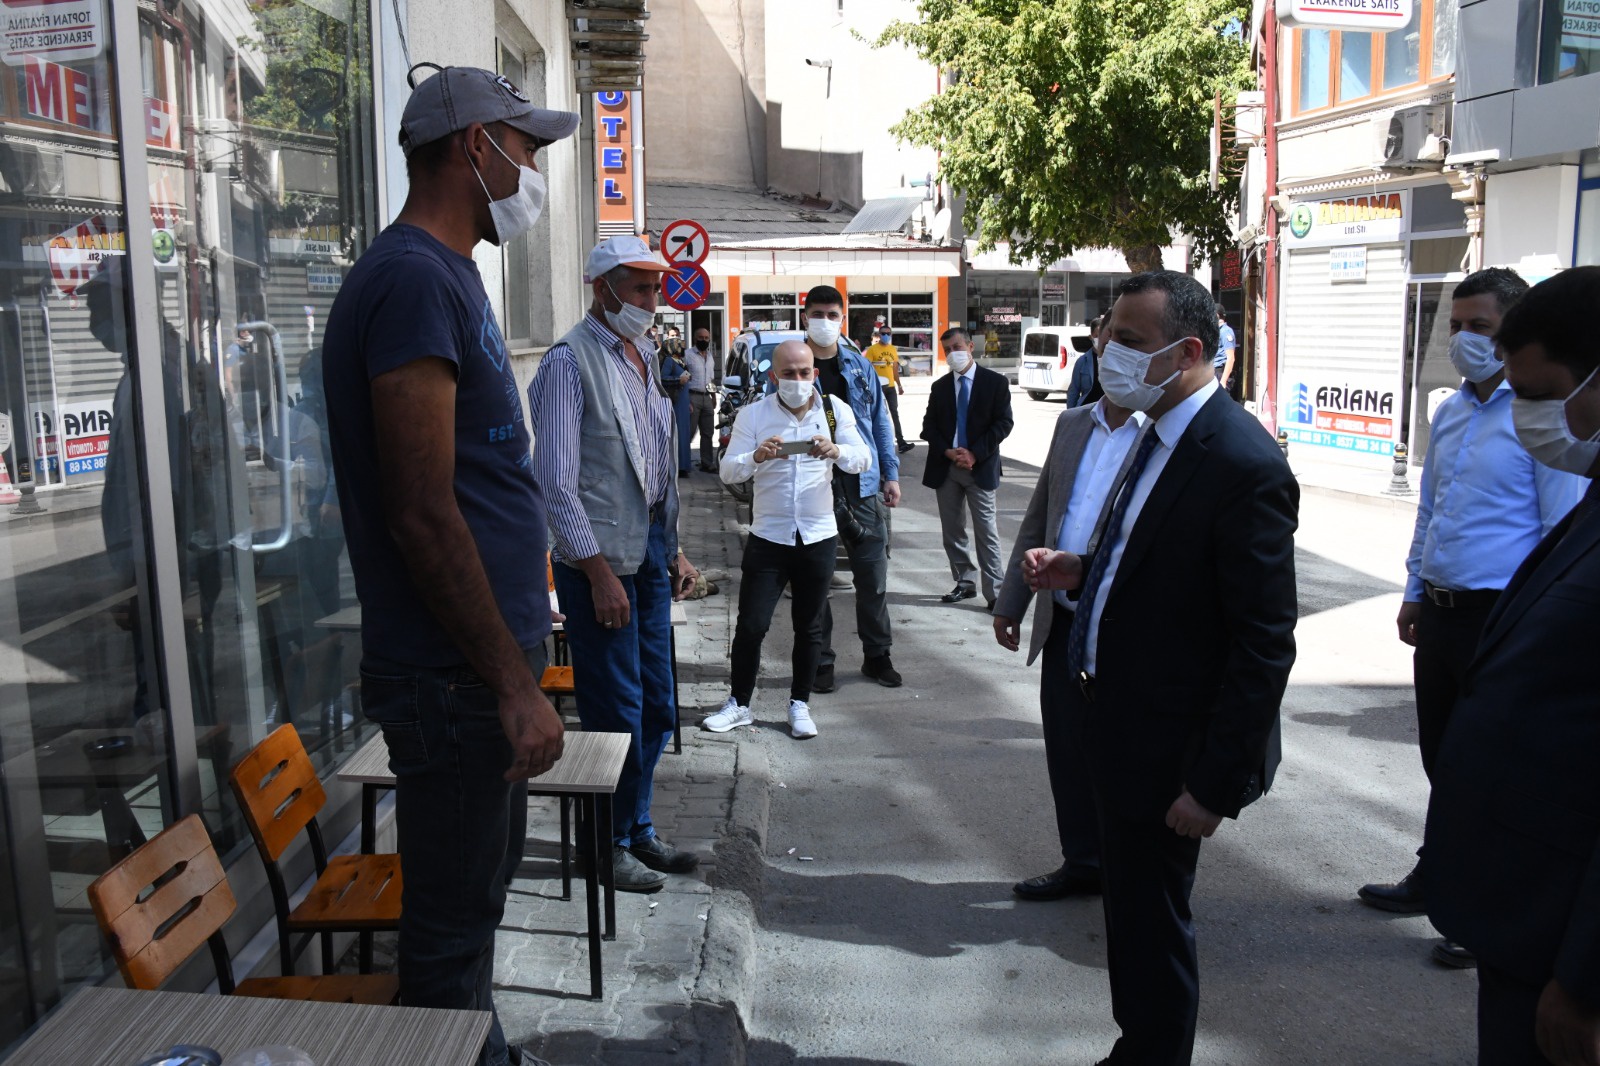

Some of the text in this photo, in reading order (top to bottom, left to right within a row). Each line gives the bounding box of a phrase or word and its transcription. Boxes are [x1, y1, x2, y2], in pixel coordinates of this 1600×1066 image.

[598, 91, 625, 200] OTEL
[1317, 193, 1402, 226] ARIANA
[1316, 383, 1393, 415] ARİANA
[489, 424, 516, 443] EST.
